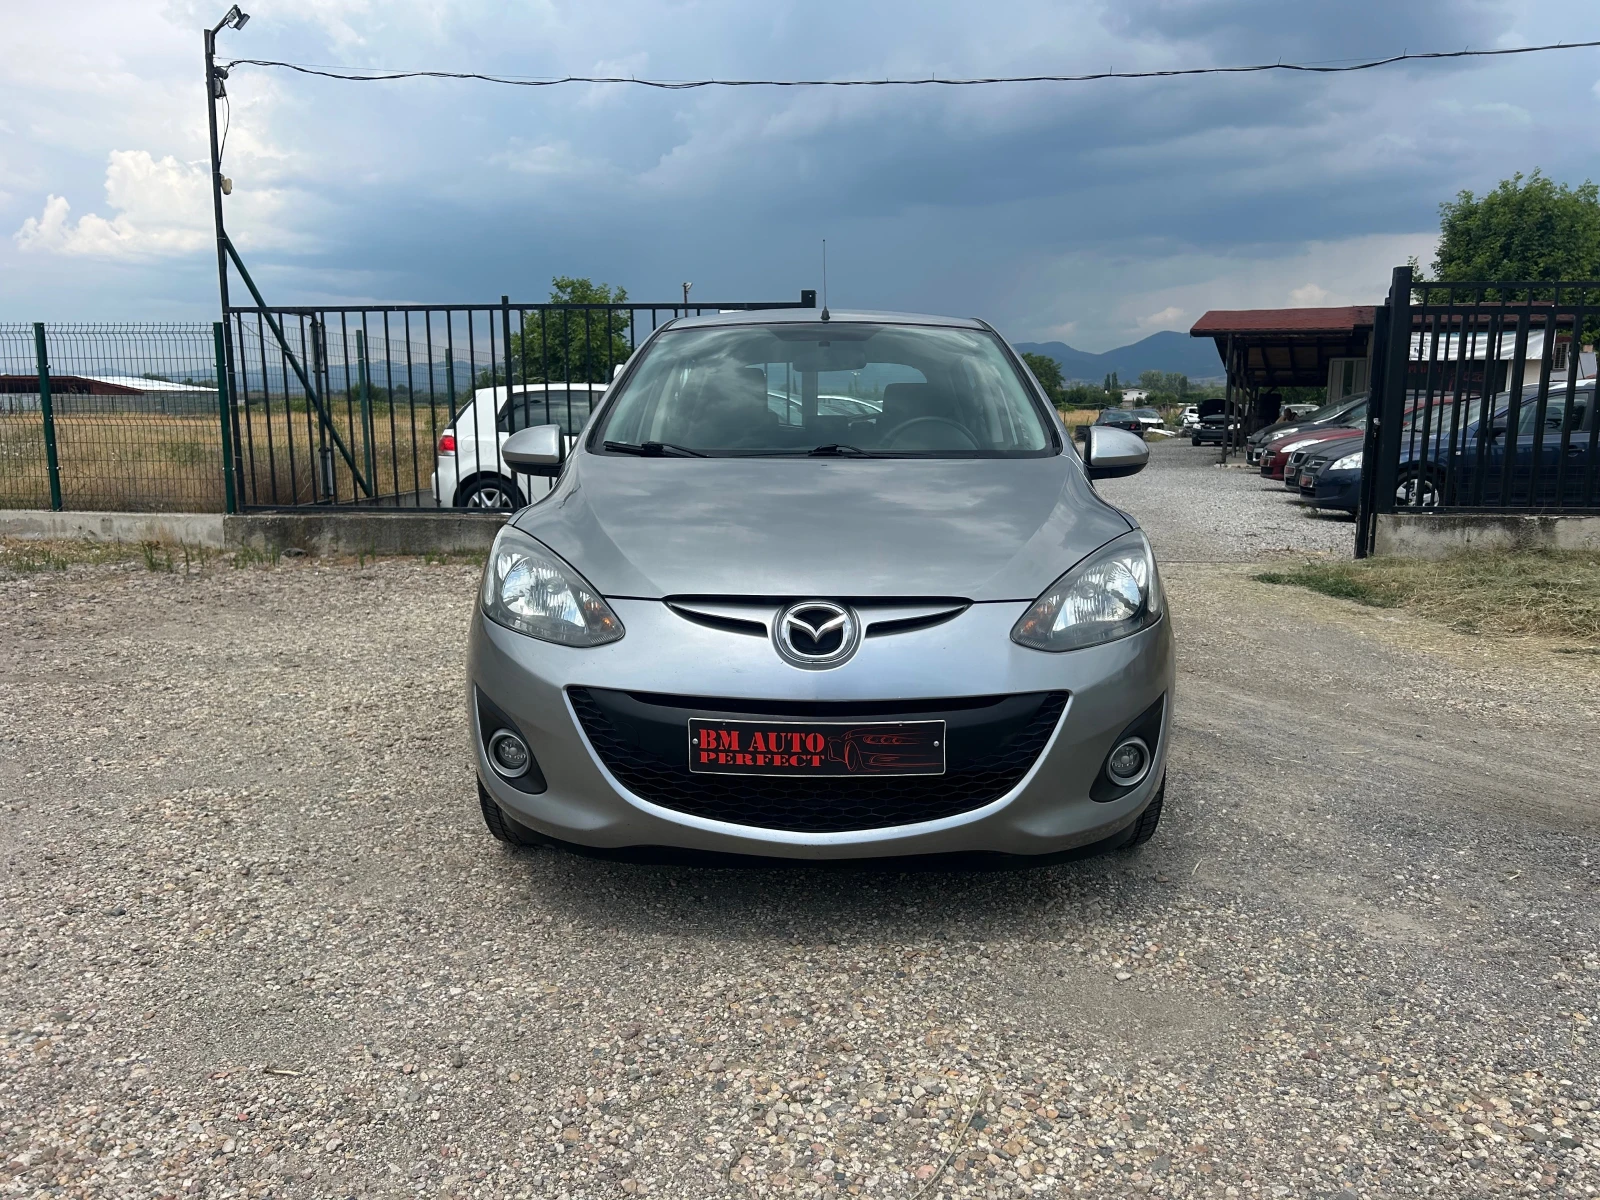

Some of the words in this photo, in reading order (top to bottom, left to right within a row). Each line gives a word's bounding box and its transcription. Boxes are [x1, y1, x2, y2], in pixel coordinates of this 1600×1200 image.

[700, 729, 740, 750] BM
[749, 732, 825, 752] AUTO
[700, 751, 825, 767] PERFECT
